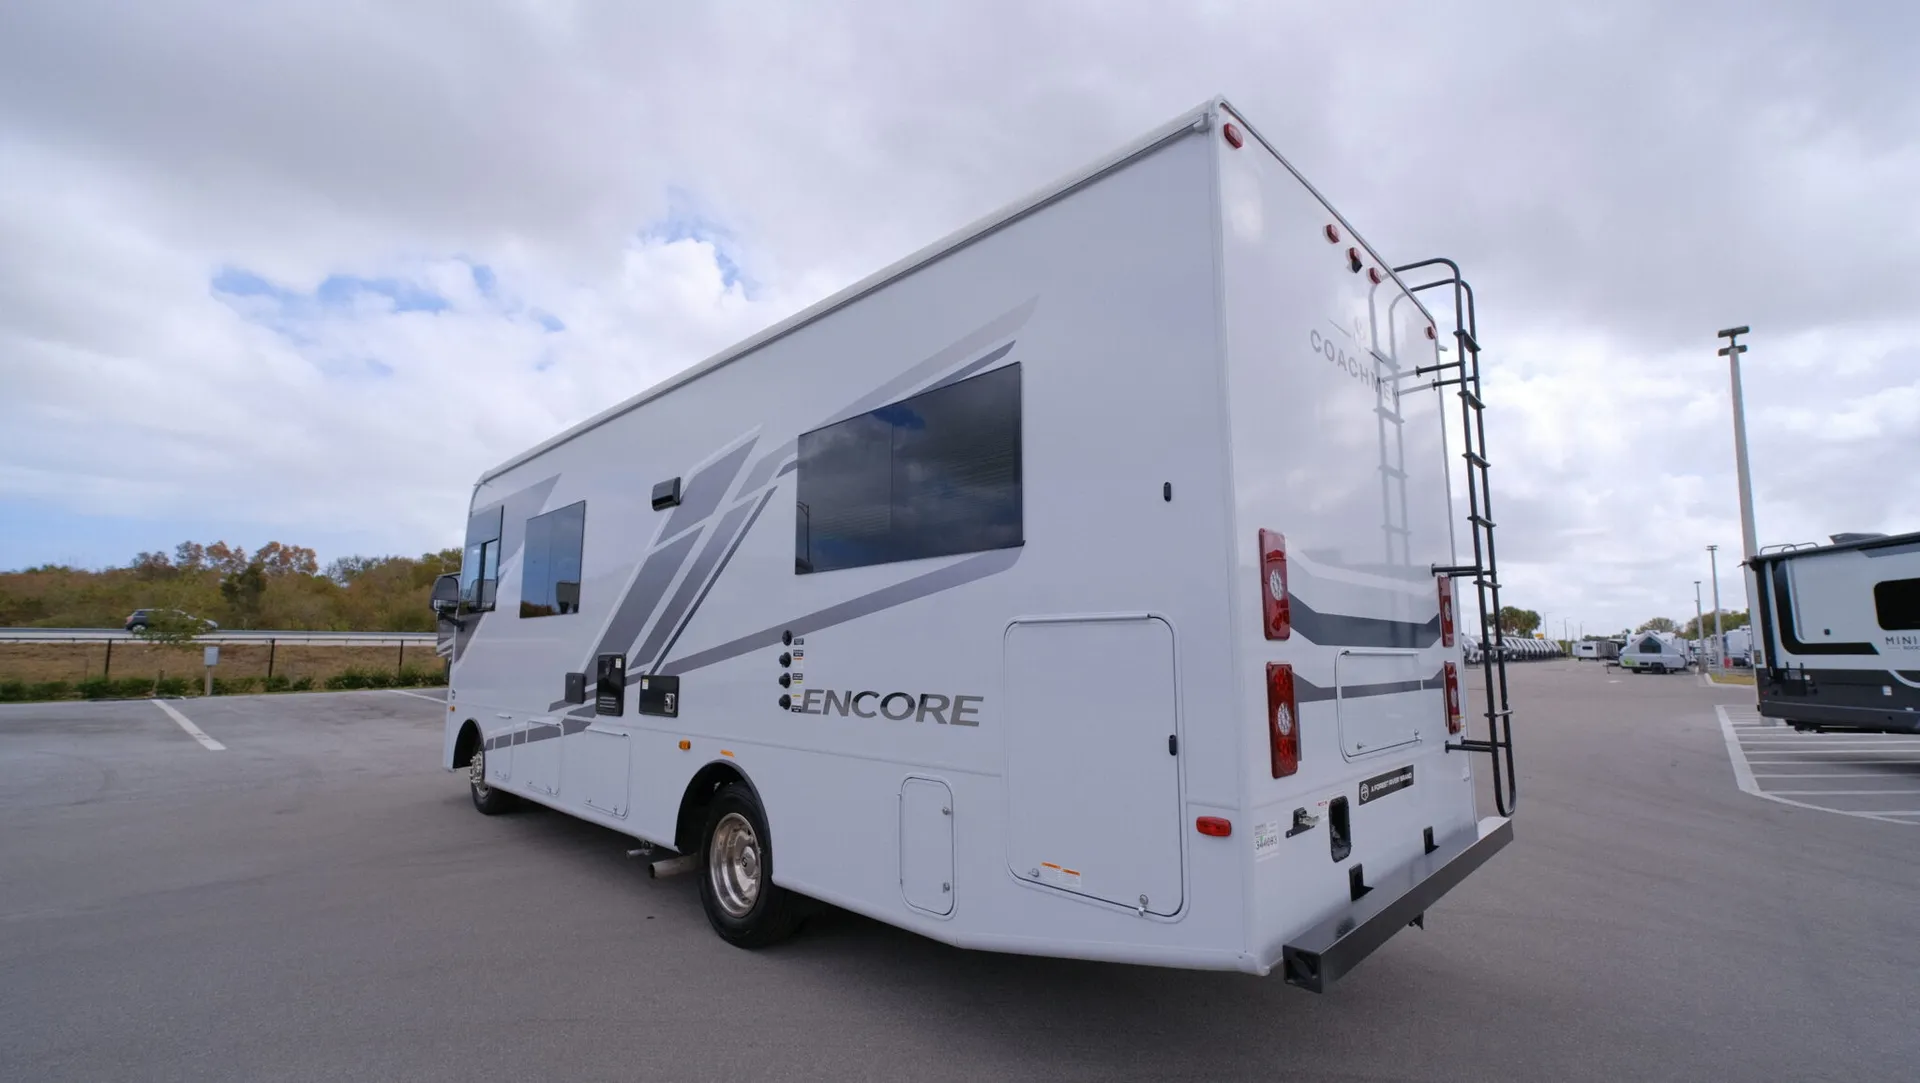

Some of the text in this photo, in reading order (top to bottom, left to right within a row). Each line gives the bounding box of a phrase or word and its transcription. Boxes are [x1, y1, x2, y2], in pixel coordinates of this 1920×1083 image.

[1310, 328, 1400, 407] COACHMEN
[1885, 635, 1917, 645] MINI
[801, 688, 984, 727] ENCORE
